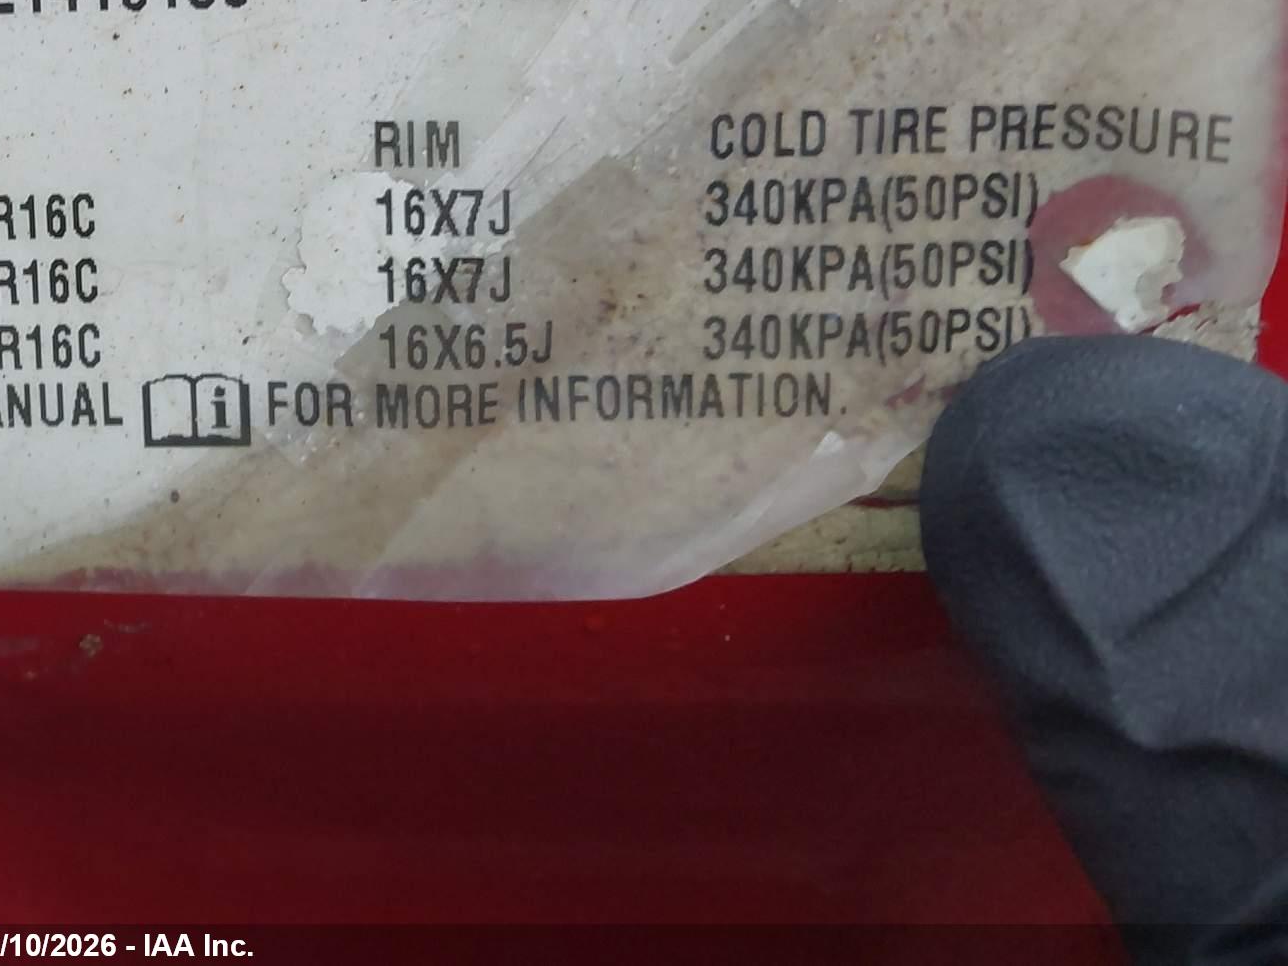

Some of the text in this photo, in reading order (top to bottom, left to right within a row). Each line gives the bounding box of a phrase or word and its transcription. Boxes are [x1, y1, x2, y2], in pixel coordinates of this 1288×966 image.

[374, 120, 460, 169] RIM
[711, 104, 1233, 164] COLD TIRE PRESSURE
[376, 188, 510, 236] 16X7J
[704, 170, 1039, 232] 340KPA(50PSI)
[377, 256, 510, 304] 16X7J
[703, 239, 1034, 299] 340KPA(50PSI)
[379, 320, 553, 370] 16X6.5J
[702, 306, 1031, 367] 340KPA(50PSI)
[268, 373, 847, 430] FOR MORE INFORMATION.
